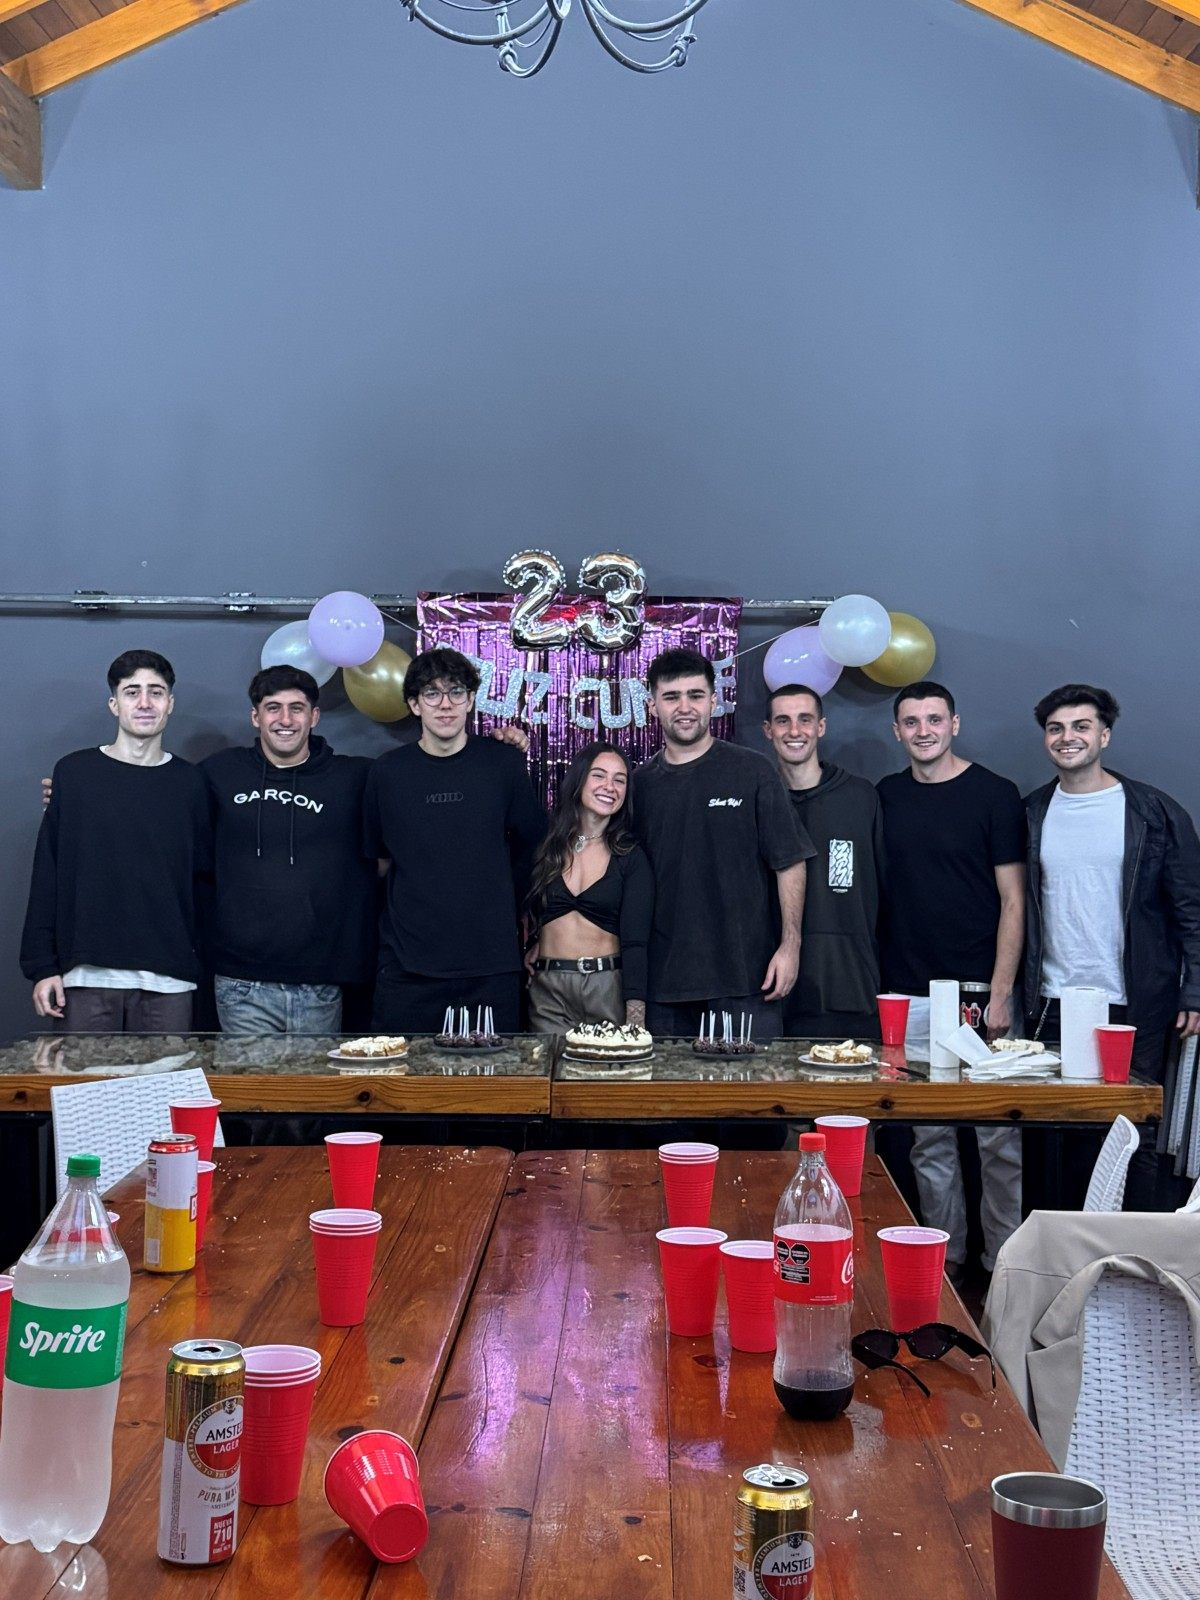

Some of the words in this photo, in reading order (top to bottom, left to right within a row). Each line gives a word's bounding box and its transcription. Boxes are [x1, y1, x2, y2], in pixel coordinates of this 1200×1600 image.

[502, 548, 648, 652] 23
[233, 789, 324, 814] GARÇON
[19, 1321, 106, 1358] Sprite
[205, 1421, 244, 1442] AMSTE
[213, 1439, 240, 1454] LAGER
[197, 1489, 222, 1503] PURA
[213, 1525, 232, 1545] 710
[770, 1556, 813, 1574] AMSTEL
[779, 1574, 808, 1587] LAGER
